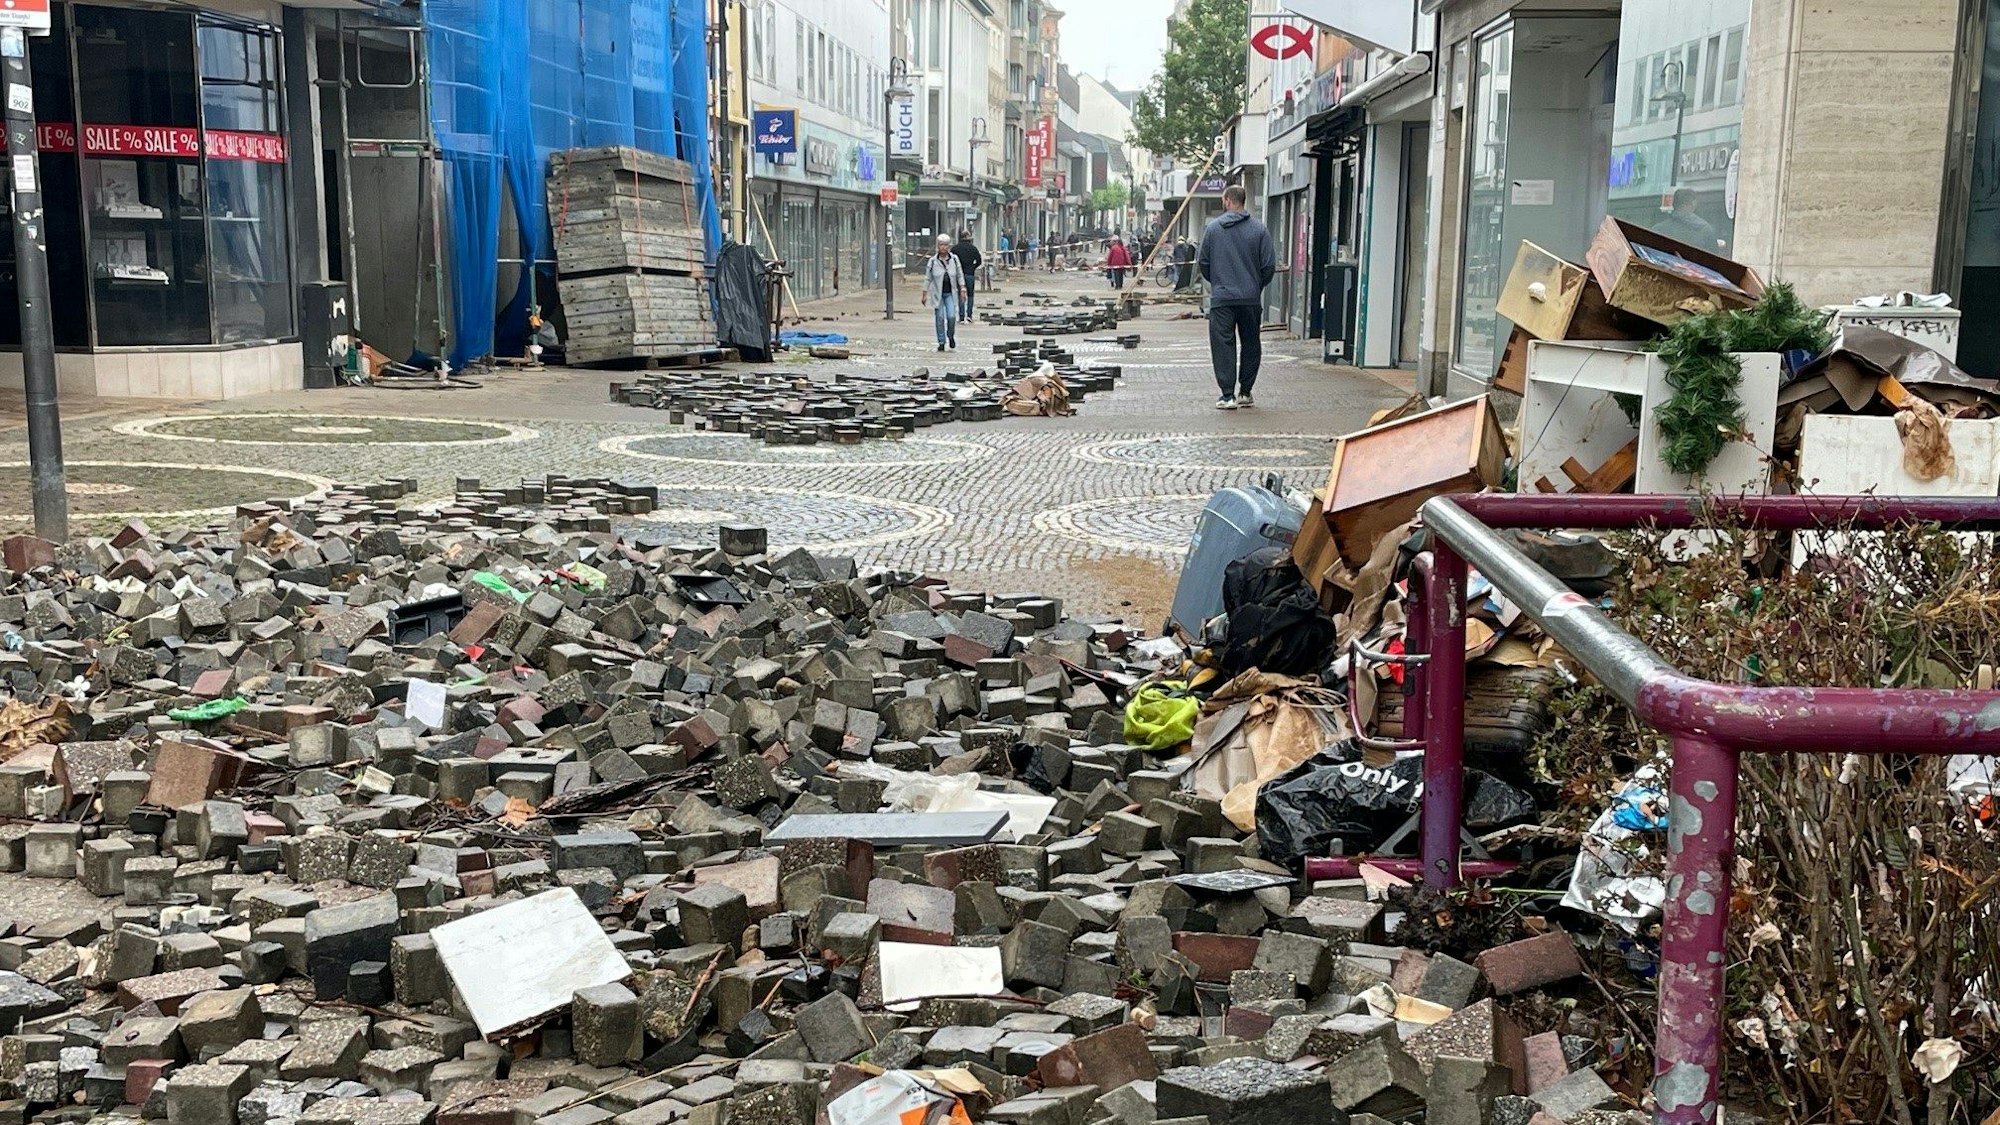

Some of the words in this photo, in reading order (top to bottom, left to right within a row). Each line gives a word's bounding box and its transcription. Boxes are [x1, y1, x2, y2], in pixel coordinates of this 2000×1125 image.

[13, 98, 29, 109] 902
[86, 127, 120, 150] SALE
[124, 131, 142, 149] %
[144, 129, 178, 153] SALE
[180, 133, 198, 152] %
[226, 134, 239, 157] SALE
[245, 136, 258, 158] SALE
[264, 138, 277, 160] SALE
[758, 134, 792, 144] Tchibo
[1029, 135, 1040, 177] WITT
[1340, 761, 1409, 793] Only
